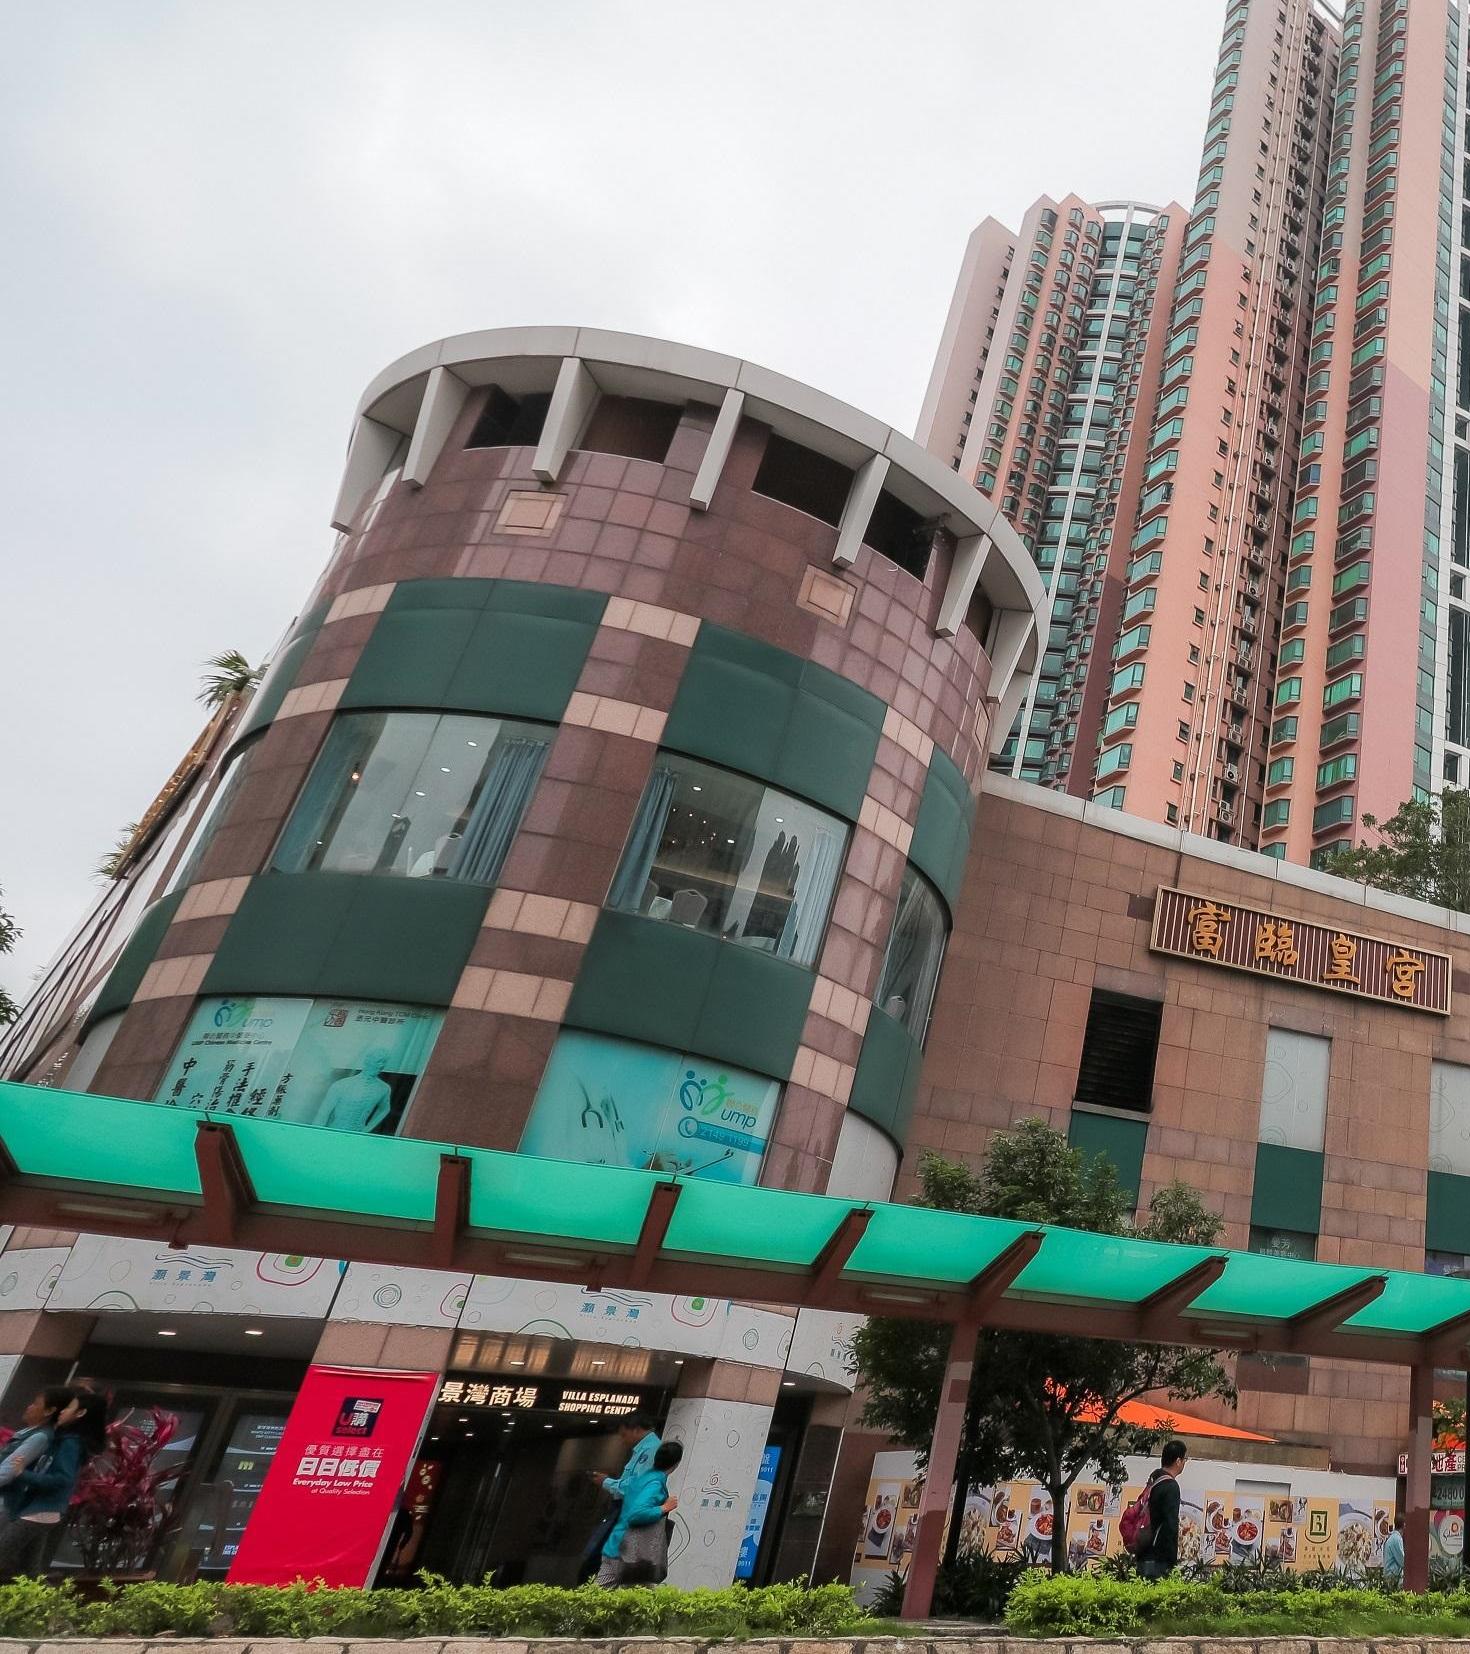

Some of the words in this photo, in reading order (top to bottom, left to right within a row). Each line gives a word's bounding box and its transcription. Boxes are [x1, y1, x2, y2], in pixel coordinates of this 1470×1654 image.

[1187, 901, 1425, 998] 富臨皇宮
[721, 1108, 757, 1129] ump
[438, 1381, 538, 1408] 景灣商場
[562, 1390, 587, 1400] VILLA
[588, 1392, 640, 1405] ESPLANADA
[558, 1402, 602, 1414] SHOPPING
[603, 1405, 637, 1415] CENTR
[296, 1457, 381, 1478] 日日低價
[293, 1478, 332, 1488] Everyday
[353, 1480, 373, 1488] Price
[319, 1487, 342, 1496] Quality
